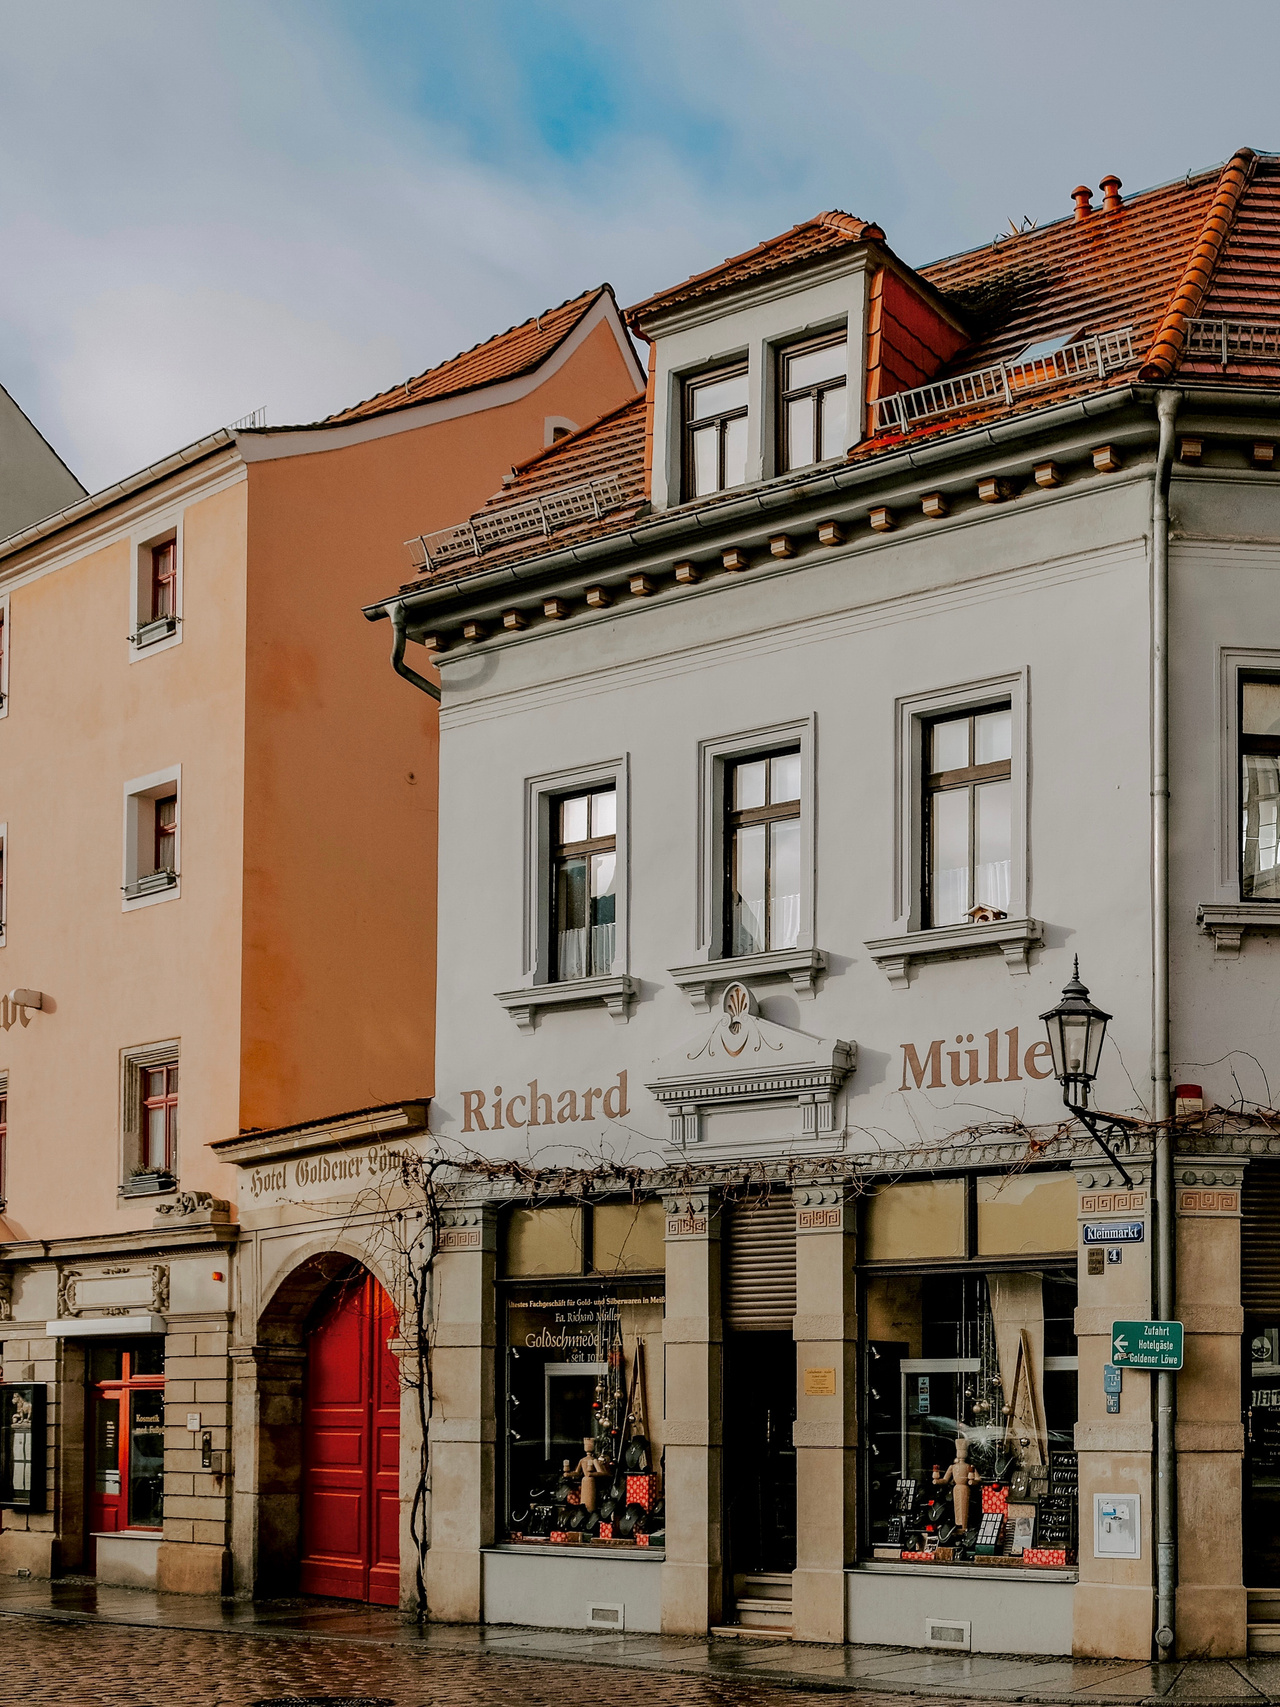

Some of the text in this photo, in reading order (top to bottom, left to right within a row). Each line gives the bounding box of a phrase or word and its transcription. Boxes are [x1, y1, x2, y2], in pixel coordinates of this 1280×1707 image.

[898, 1026, 1054, 1091] Mülle
[460, 1069, 631, 1134] Richard
[250, 1163, 288, 1199] Hotel
[294, 1155, 364, 1188] Goldener
[1087, 1226, 1139, 1240] Kleinmarkt
[1109, 1249, 1119, 1262] 4
[1144, 1326, 1170, 1336] Zufahrt
[1138, 1339, 1174, 1352] Hotelgäste
[1128, 1353, 1178, 1365] Goldener Löwe
